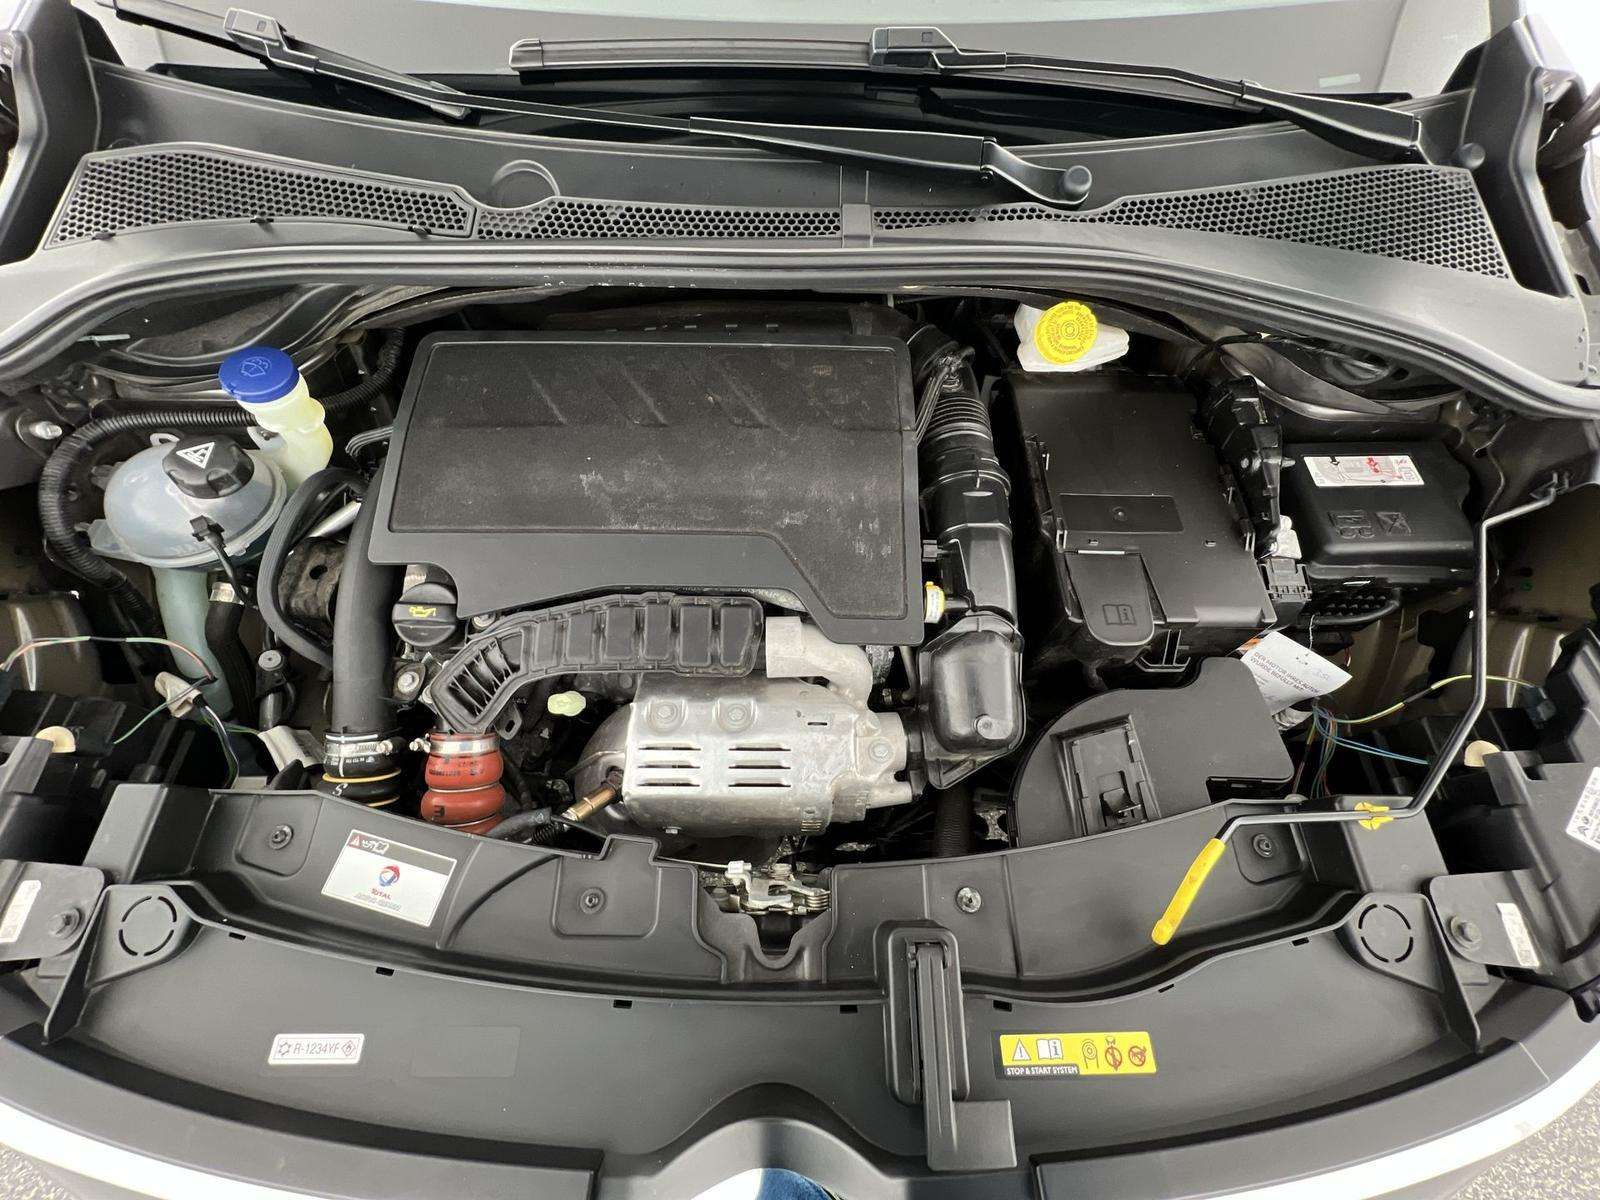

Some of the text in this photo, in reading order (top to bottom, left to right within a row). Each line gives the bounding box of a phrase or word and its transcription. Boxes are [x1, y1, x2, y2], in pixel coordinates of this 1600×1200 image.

[371, 888, 393, 901] TOTAL
[1006, 1066, 1025, 1076] STOP
[1031, 1066, 1051, 1075] START
[1052, 1065, 1078, 1075] SYSTEM
